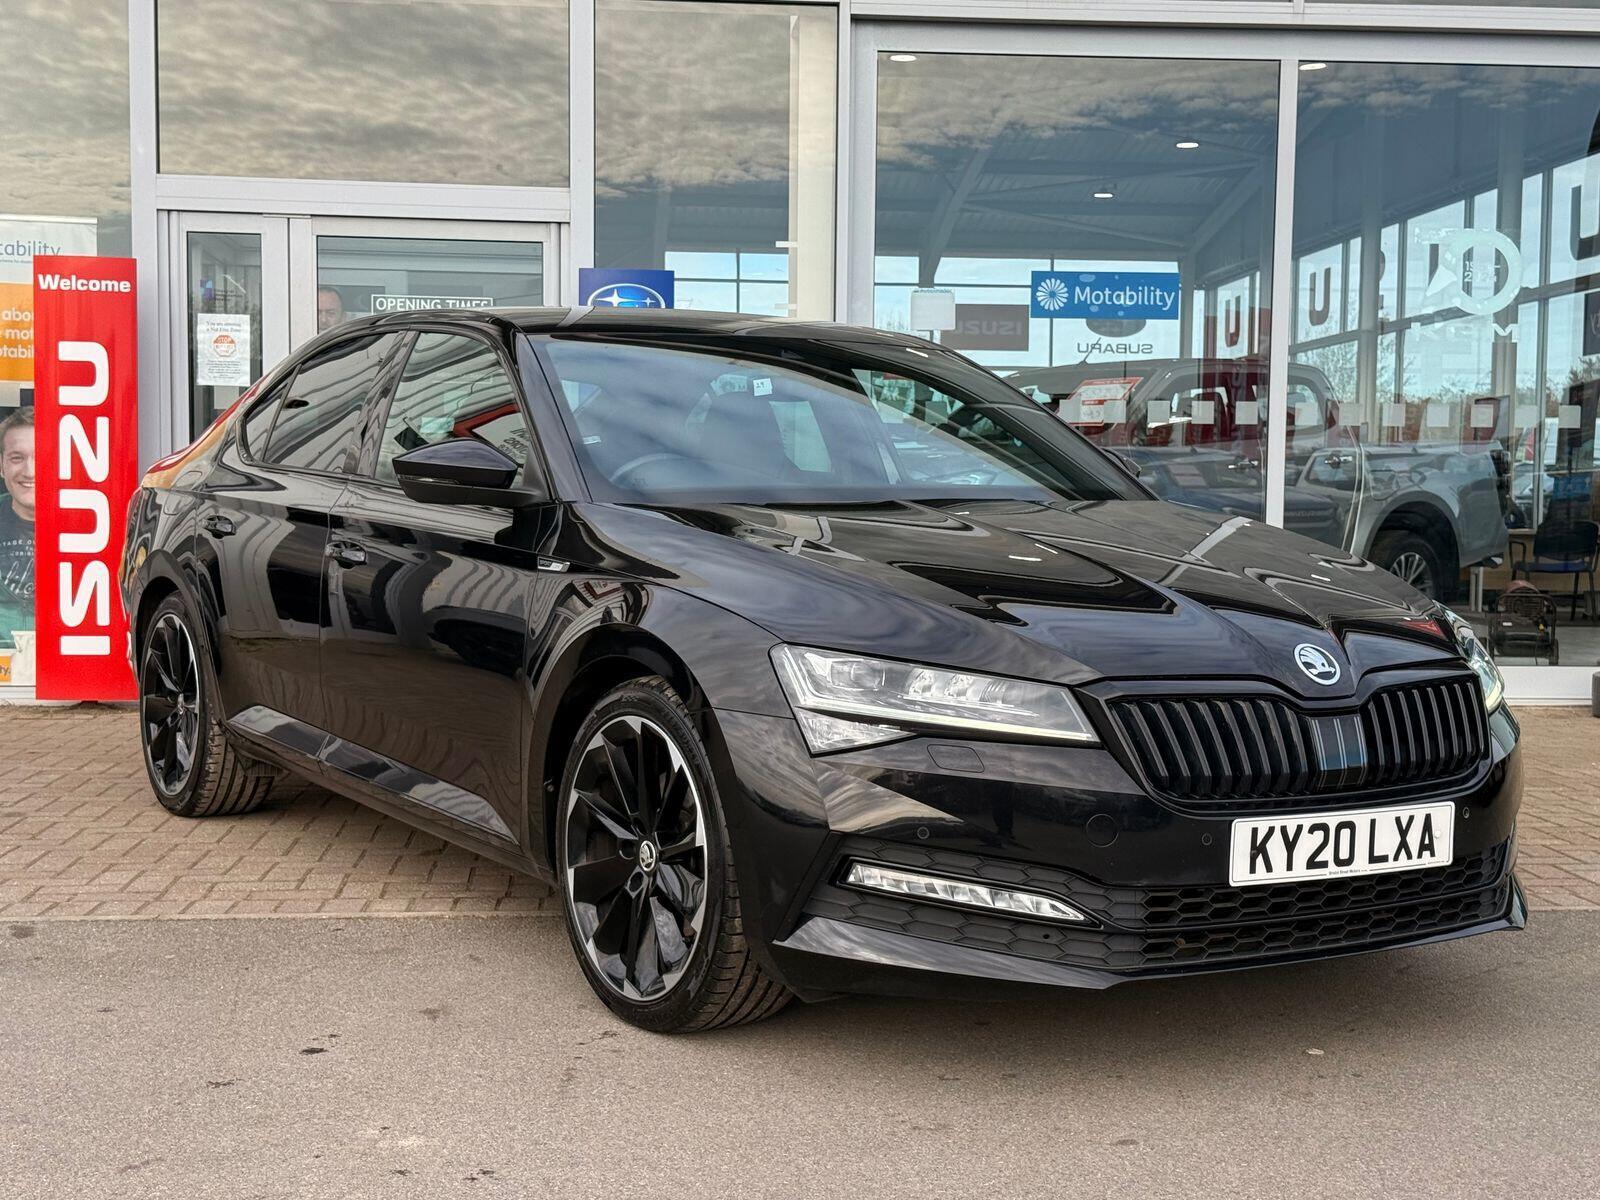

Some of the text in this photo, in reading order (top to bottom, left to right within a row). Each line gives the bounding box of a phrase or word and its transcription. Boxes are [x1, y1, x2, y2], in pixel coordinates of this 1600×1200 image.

[37, 273, 131, 293] Welcome
[376, 298, 441, 311] OPENING
[1074, 286, 1175, 310] Motability
[58, 340, 110, 655] ISUZU
[1249, 813, 1436, 874] KY20 LXA
